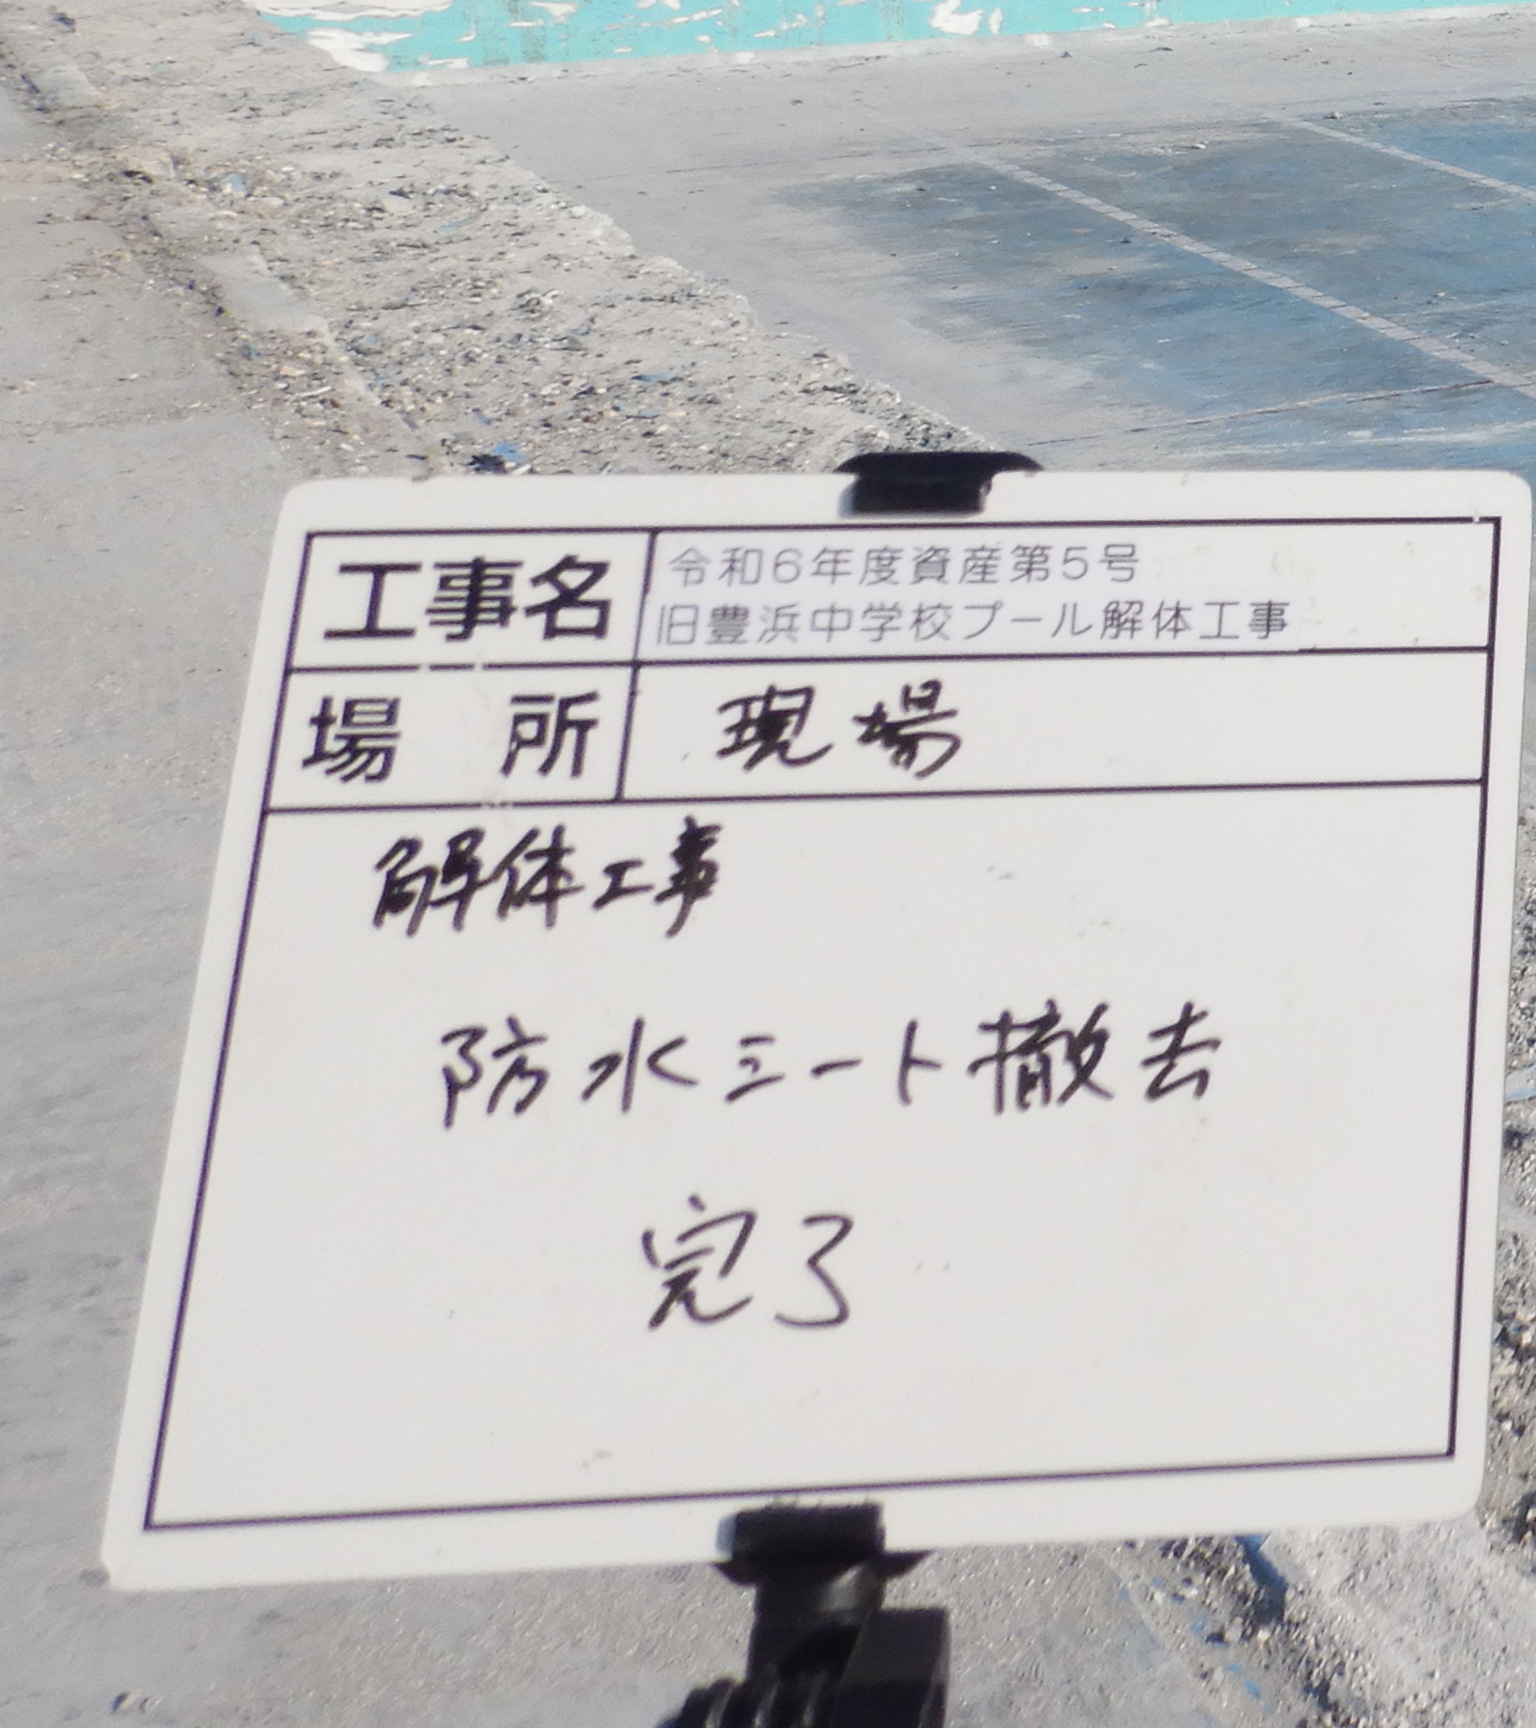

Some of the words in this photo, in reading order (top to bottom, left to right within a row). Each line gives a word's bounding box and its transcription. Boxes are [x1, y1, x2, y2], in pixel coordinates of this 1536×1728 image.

[322, 553, 613, 643] 工事名
[668, 543, 1140, 587] 令和6年度資産第5号
[656, 598, 1291, 646] 旧豊浜中学校プール解体工事
[715, 678, 963, 779] 現場
[372, 815, 723, 939] 解体工事
[439, 998, 1221, 1130] 防水シート撤去
[640, 1194, 854, 1330] 完了
